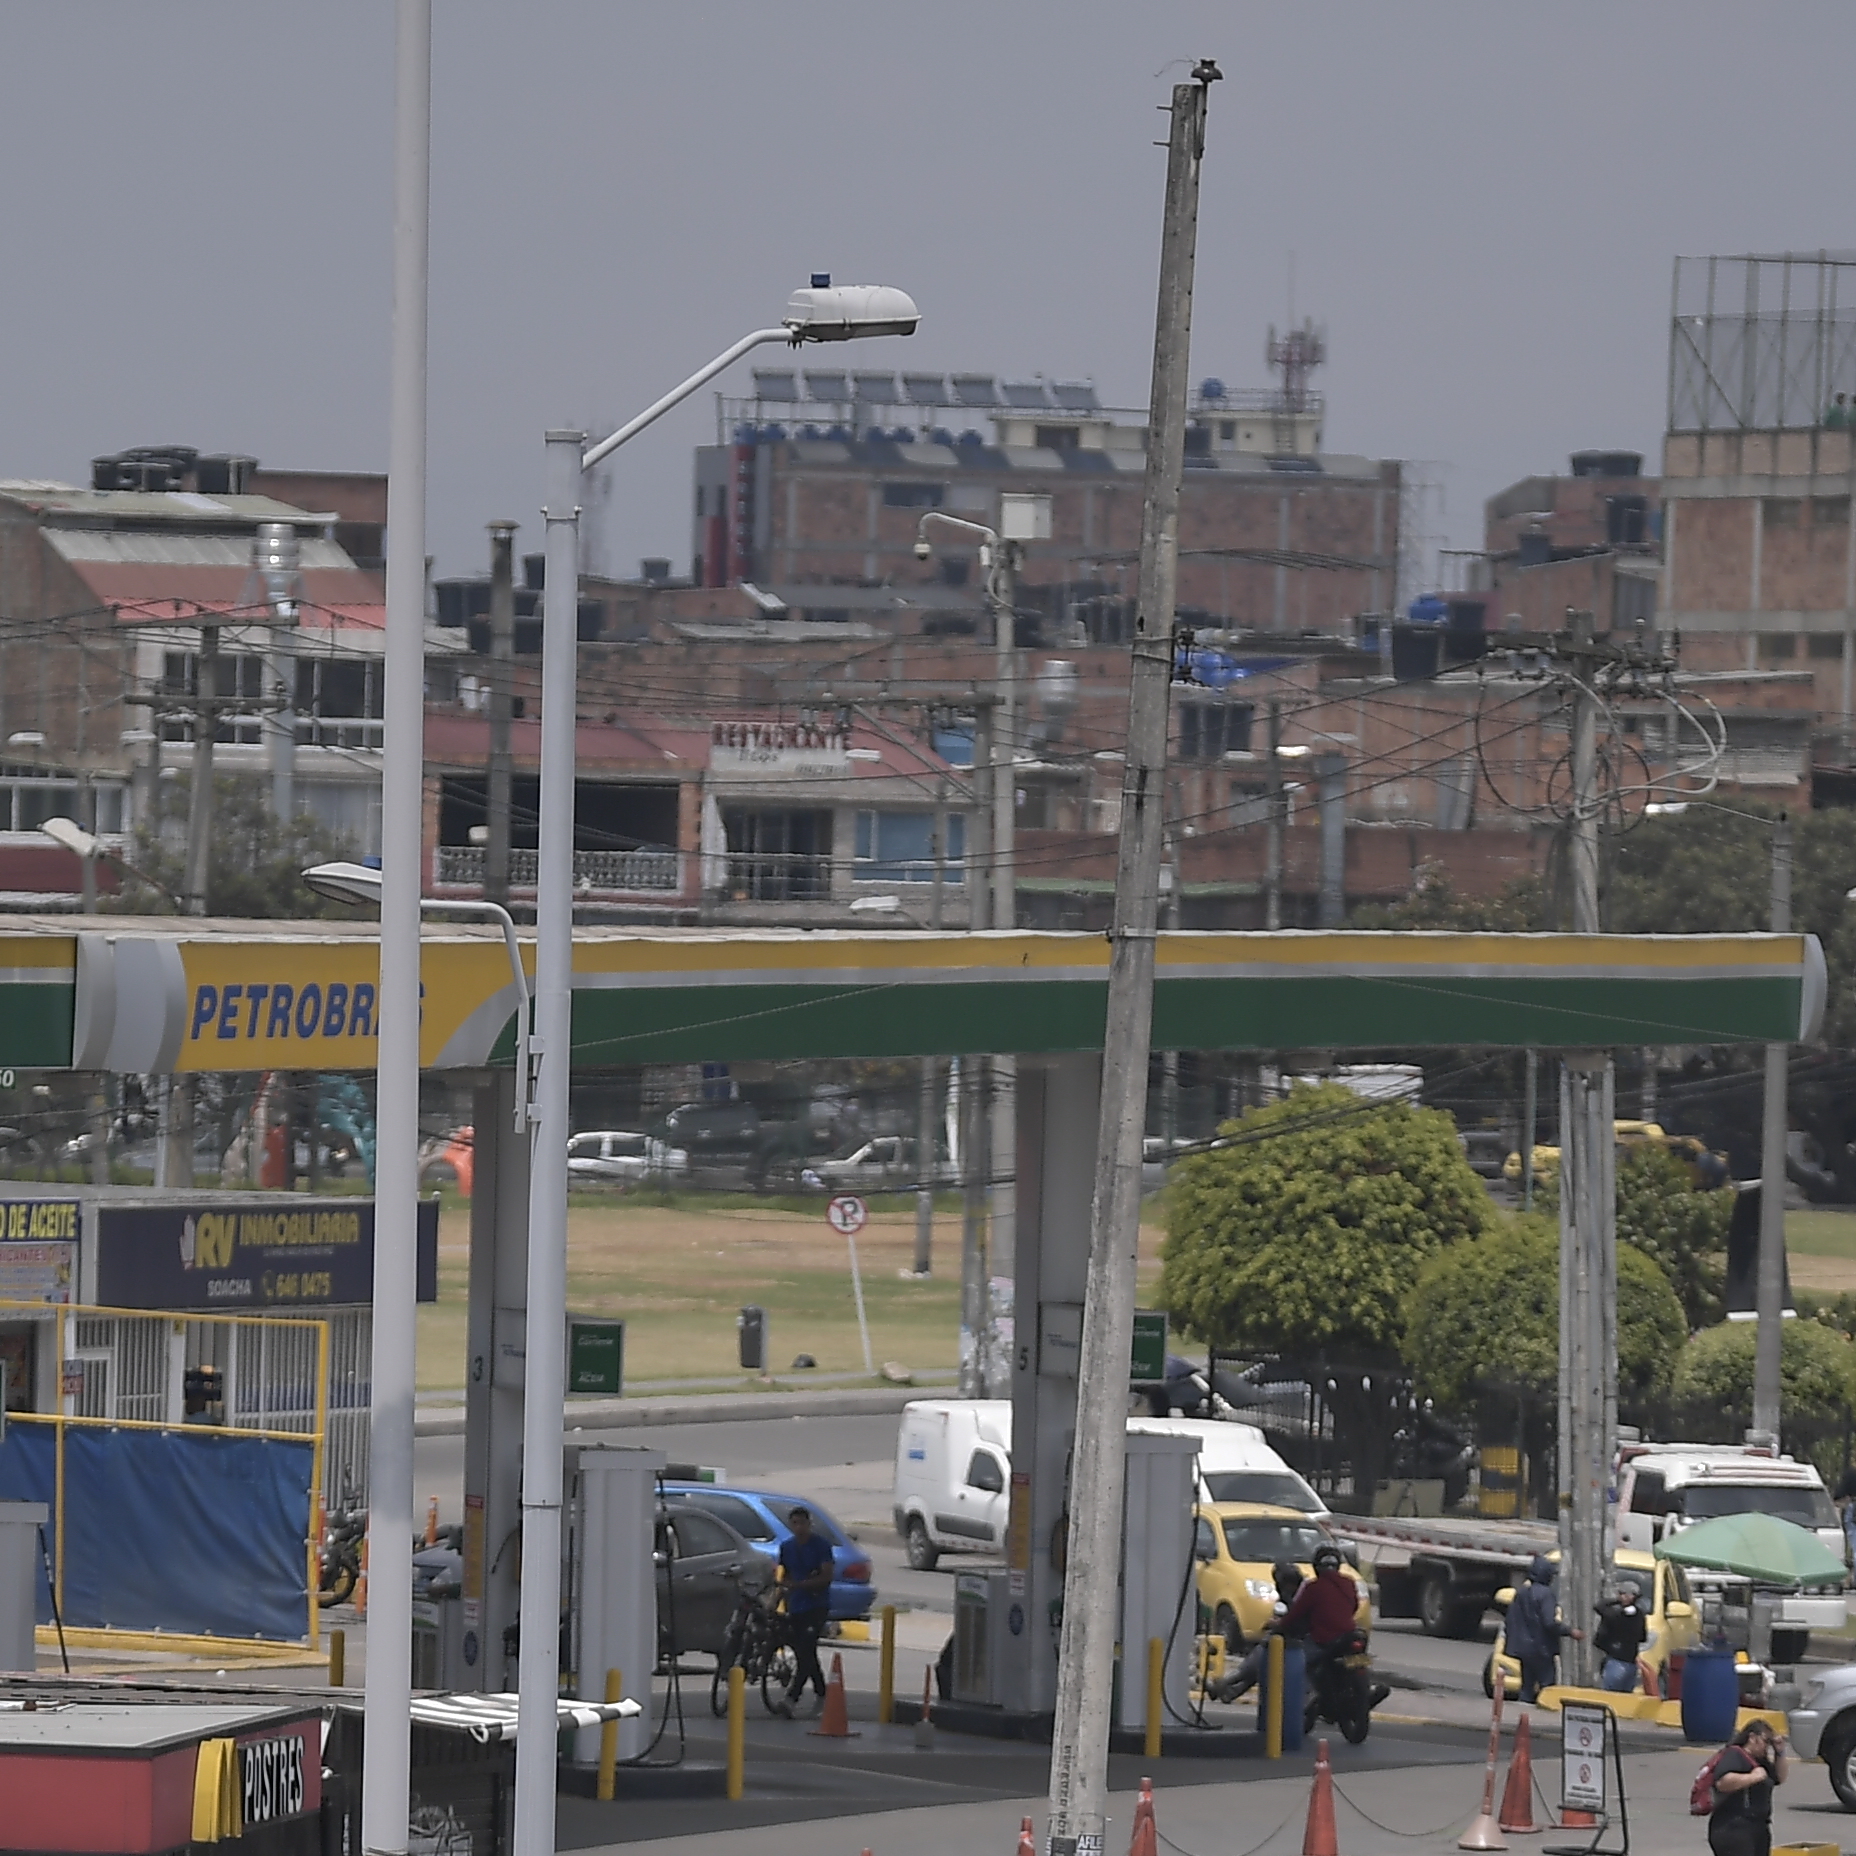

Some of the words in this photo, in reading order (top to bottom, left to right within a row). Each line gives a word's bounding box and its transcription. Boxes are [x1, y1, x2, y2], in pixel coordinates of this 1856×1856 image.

[190, 983, 425, 1041] PETROBR
[7, 1204, 25, 1239] DE
[27, 1203, 76, 1239] ACEITE
[195, 1212, 236, 1268] RV
[239, 1213, 361, 1246] INMOBILIARIA
[207, 1278, 253, 1298] SOACHA
[244, 1736, 304, 1824] POSTRES
